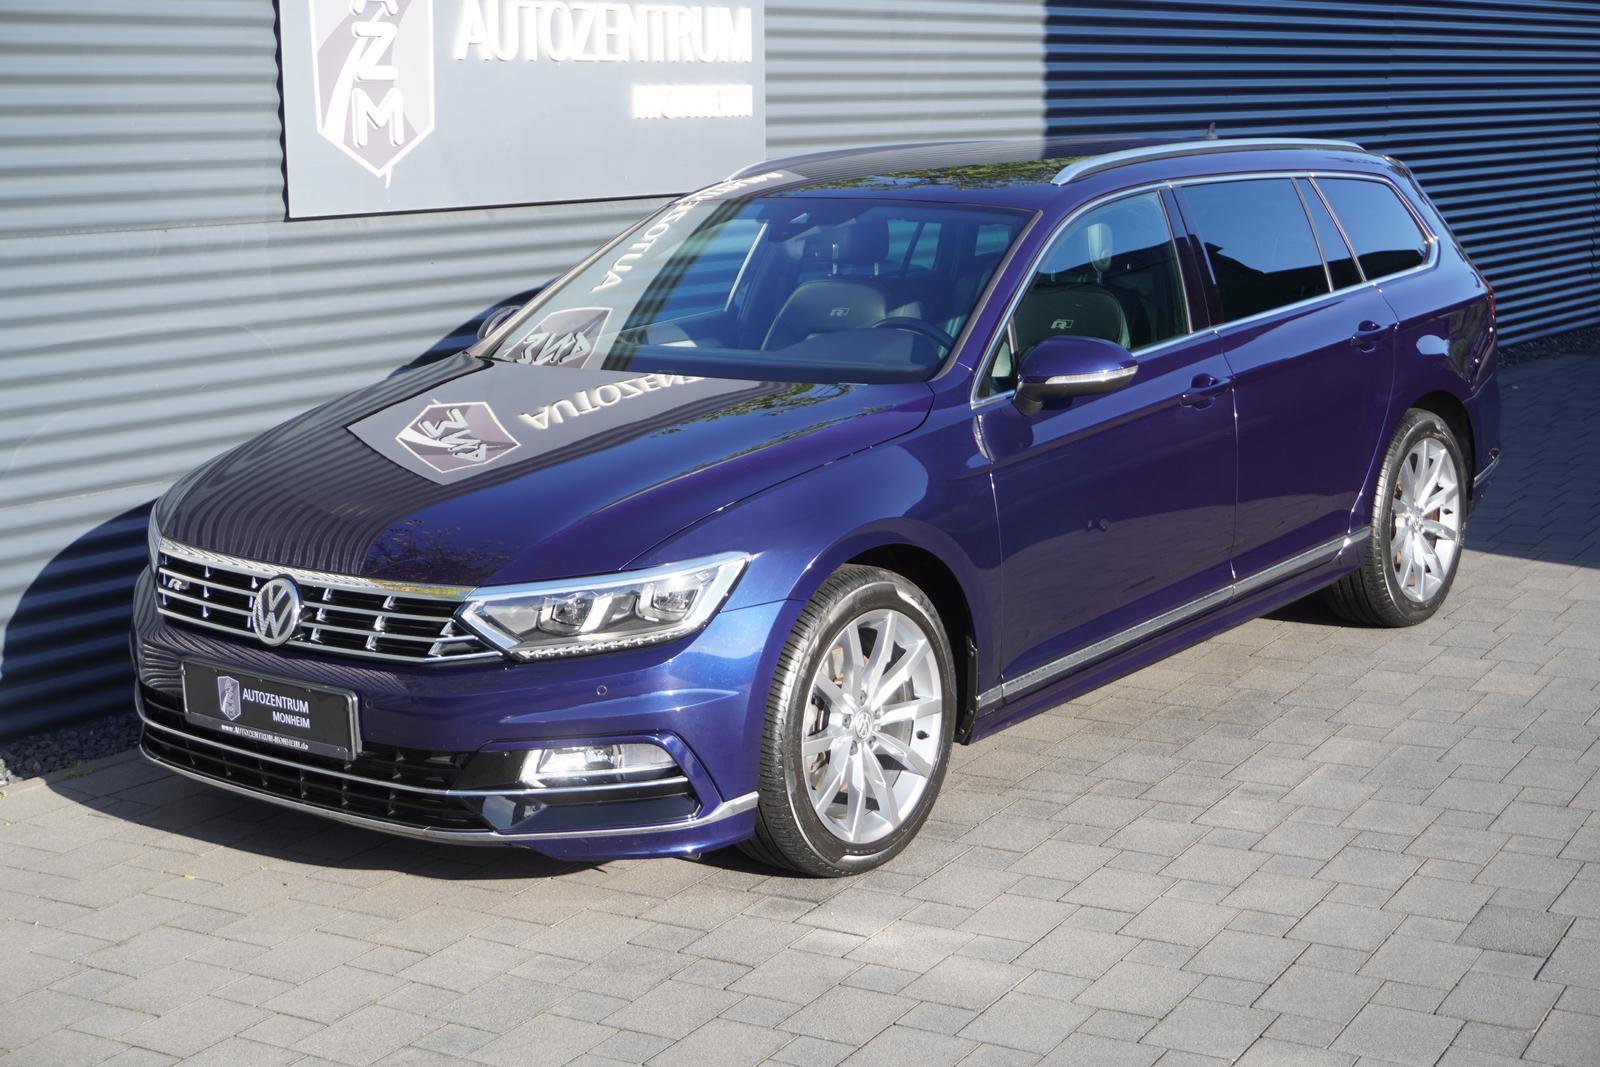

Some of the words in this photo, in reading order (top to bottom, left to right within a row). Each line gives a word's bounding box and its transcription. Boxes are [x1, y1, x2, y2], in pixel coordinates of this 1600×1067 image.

[452, 0, 752, 62] AUTOZENTRUM
[349, 0, 404, 147] ZM
[253, 577, 301, 646] VW
[242, 687, 309, 714] AUTOZENTRUM
[272, 710, 311, 729] MONHEIM
